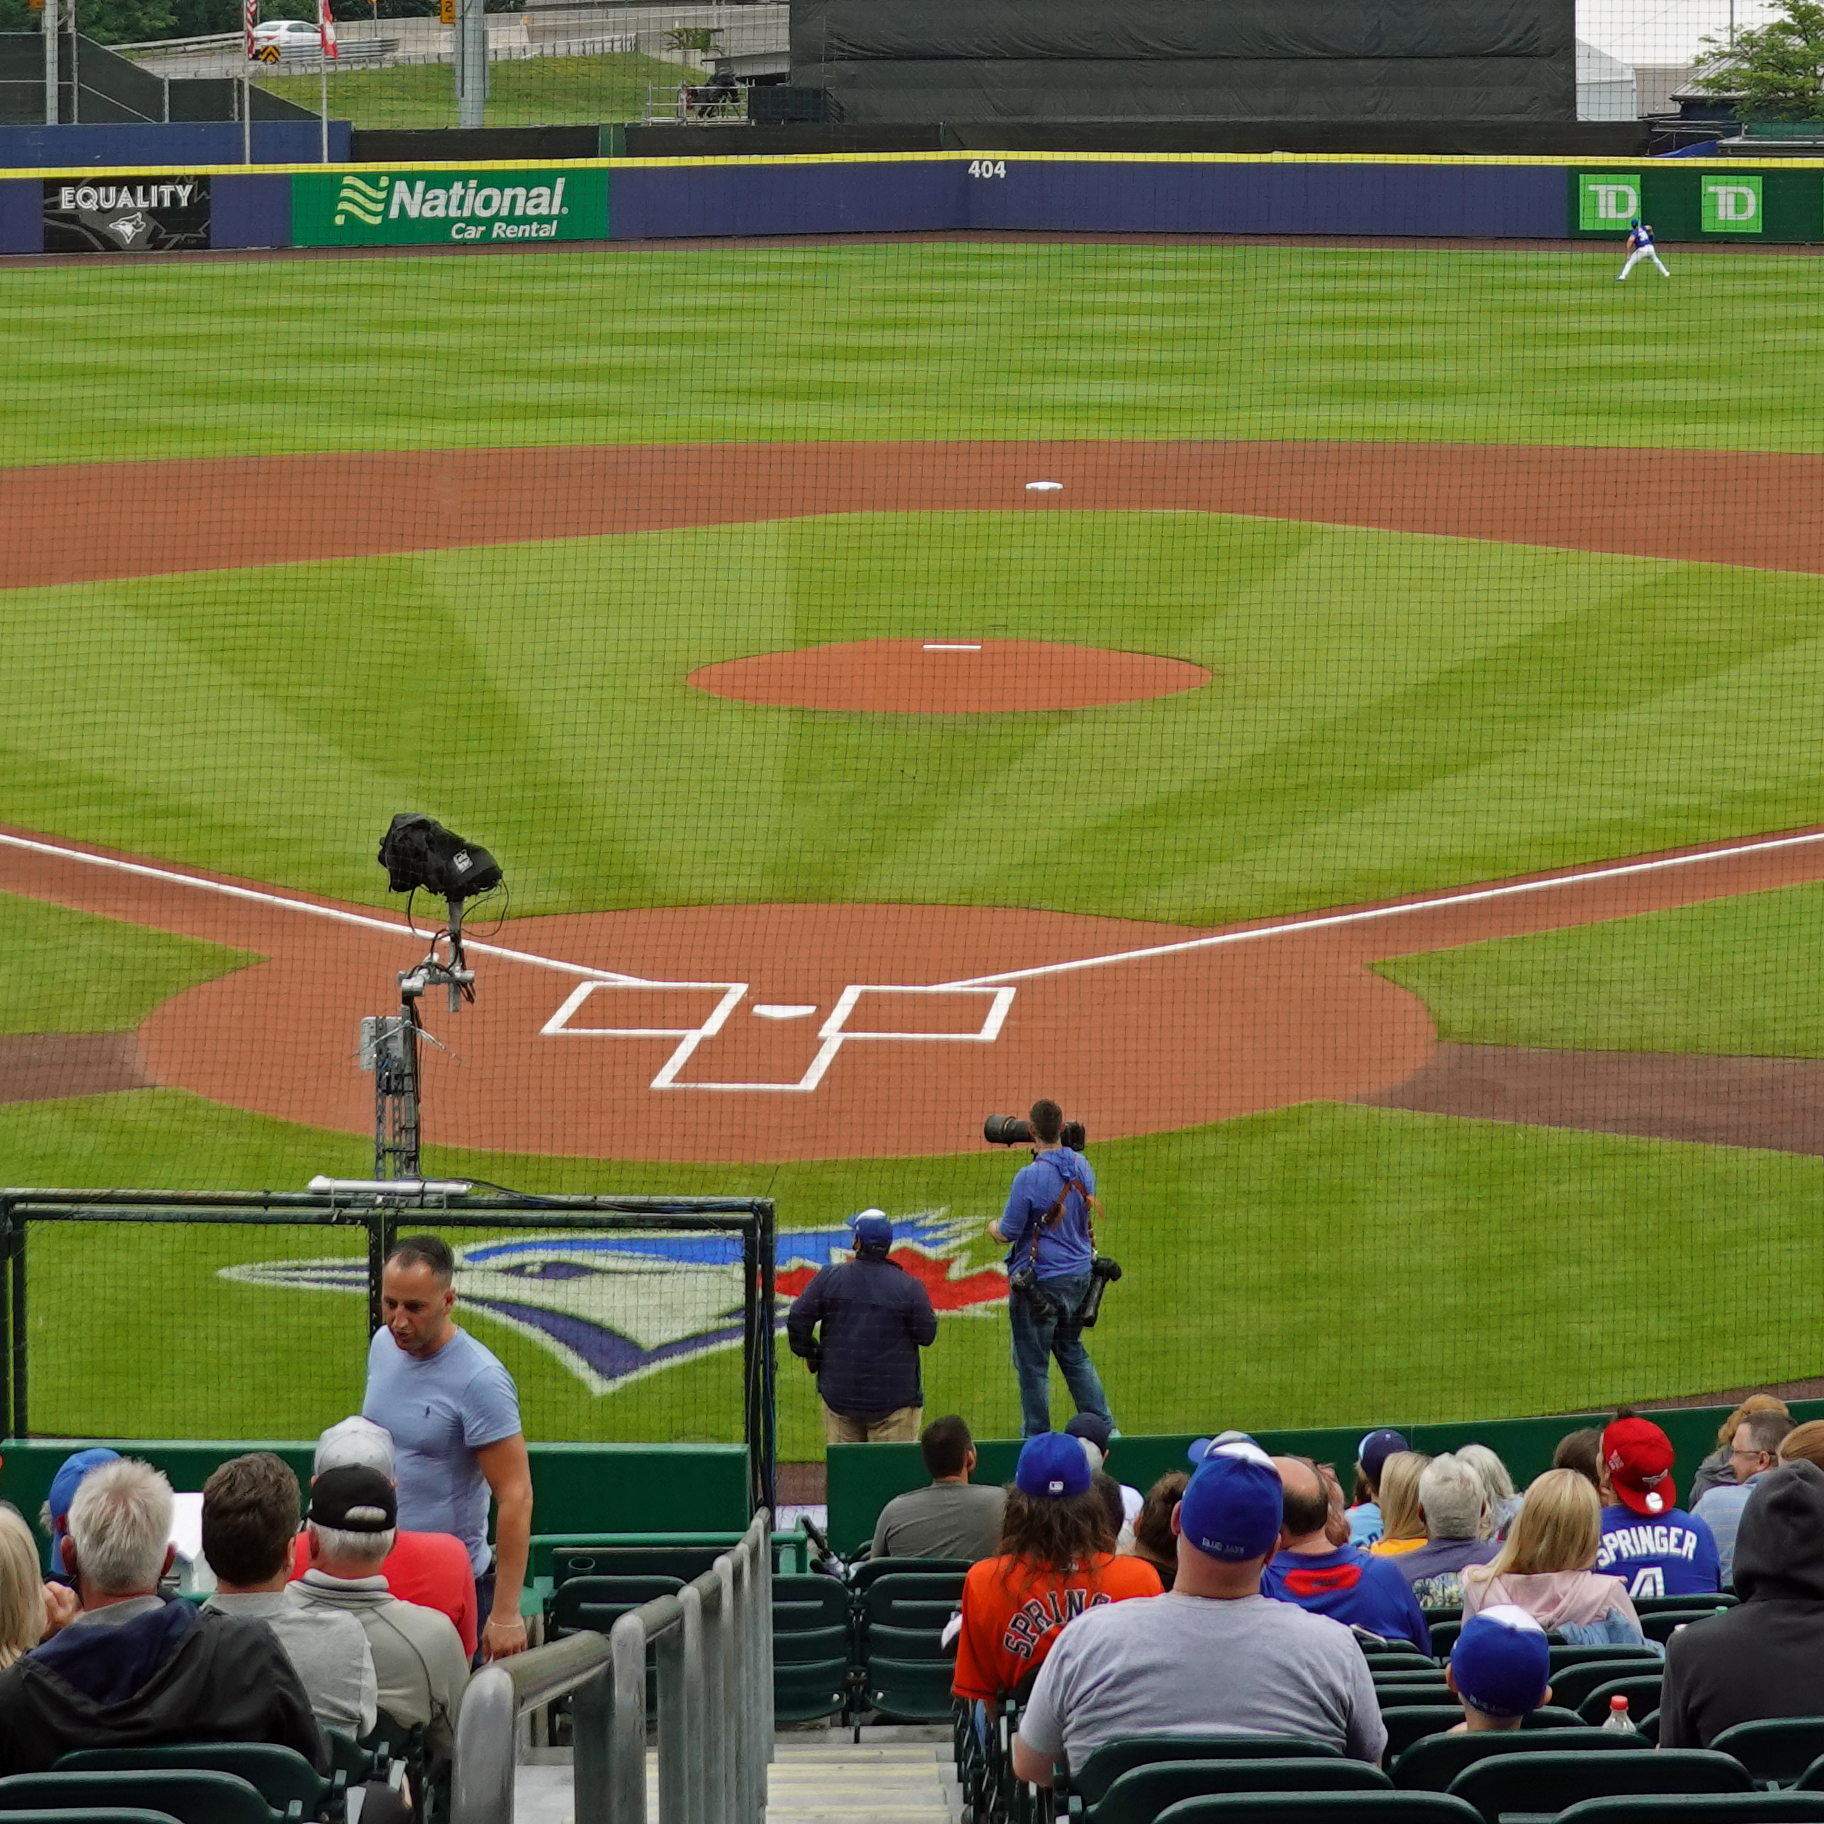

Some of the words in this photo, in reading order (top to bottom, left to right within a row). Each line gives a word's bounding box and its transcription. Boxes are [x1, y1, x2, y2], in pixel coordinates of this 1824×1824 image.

[968, 160, 1007, 179] 404
[60, 184, 194, 210] EQUALITY
[388, 177, 566, 219] National
[1588, 184, 1638, 219] TD
[1708, 186, 1756, 221] TD
[451, 222, 485, 239] Car
[492, 220, 558, 238] Rental
[1596, 1524, 1698, 1568] SPRINGER
